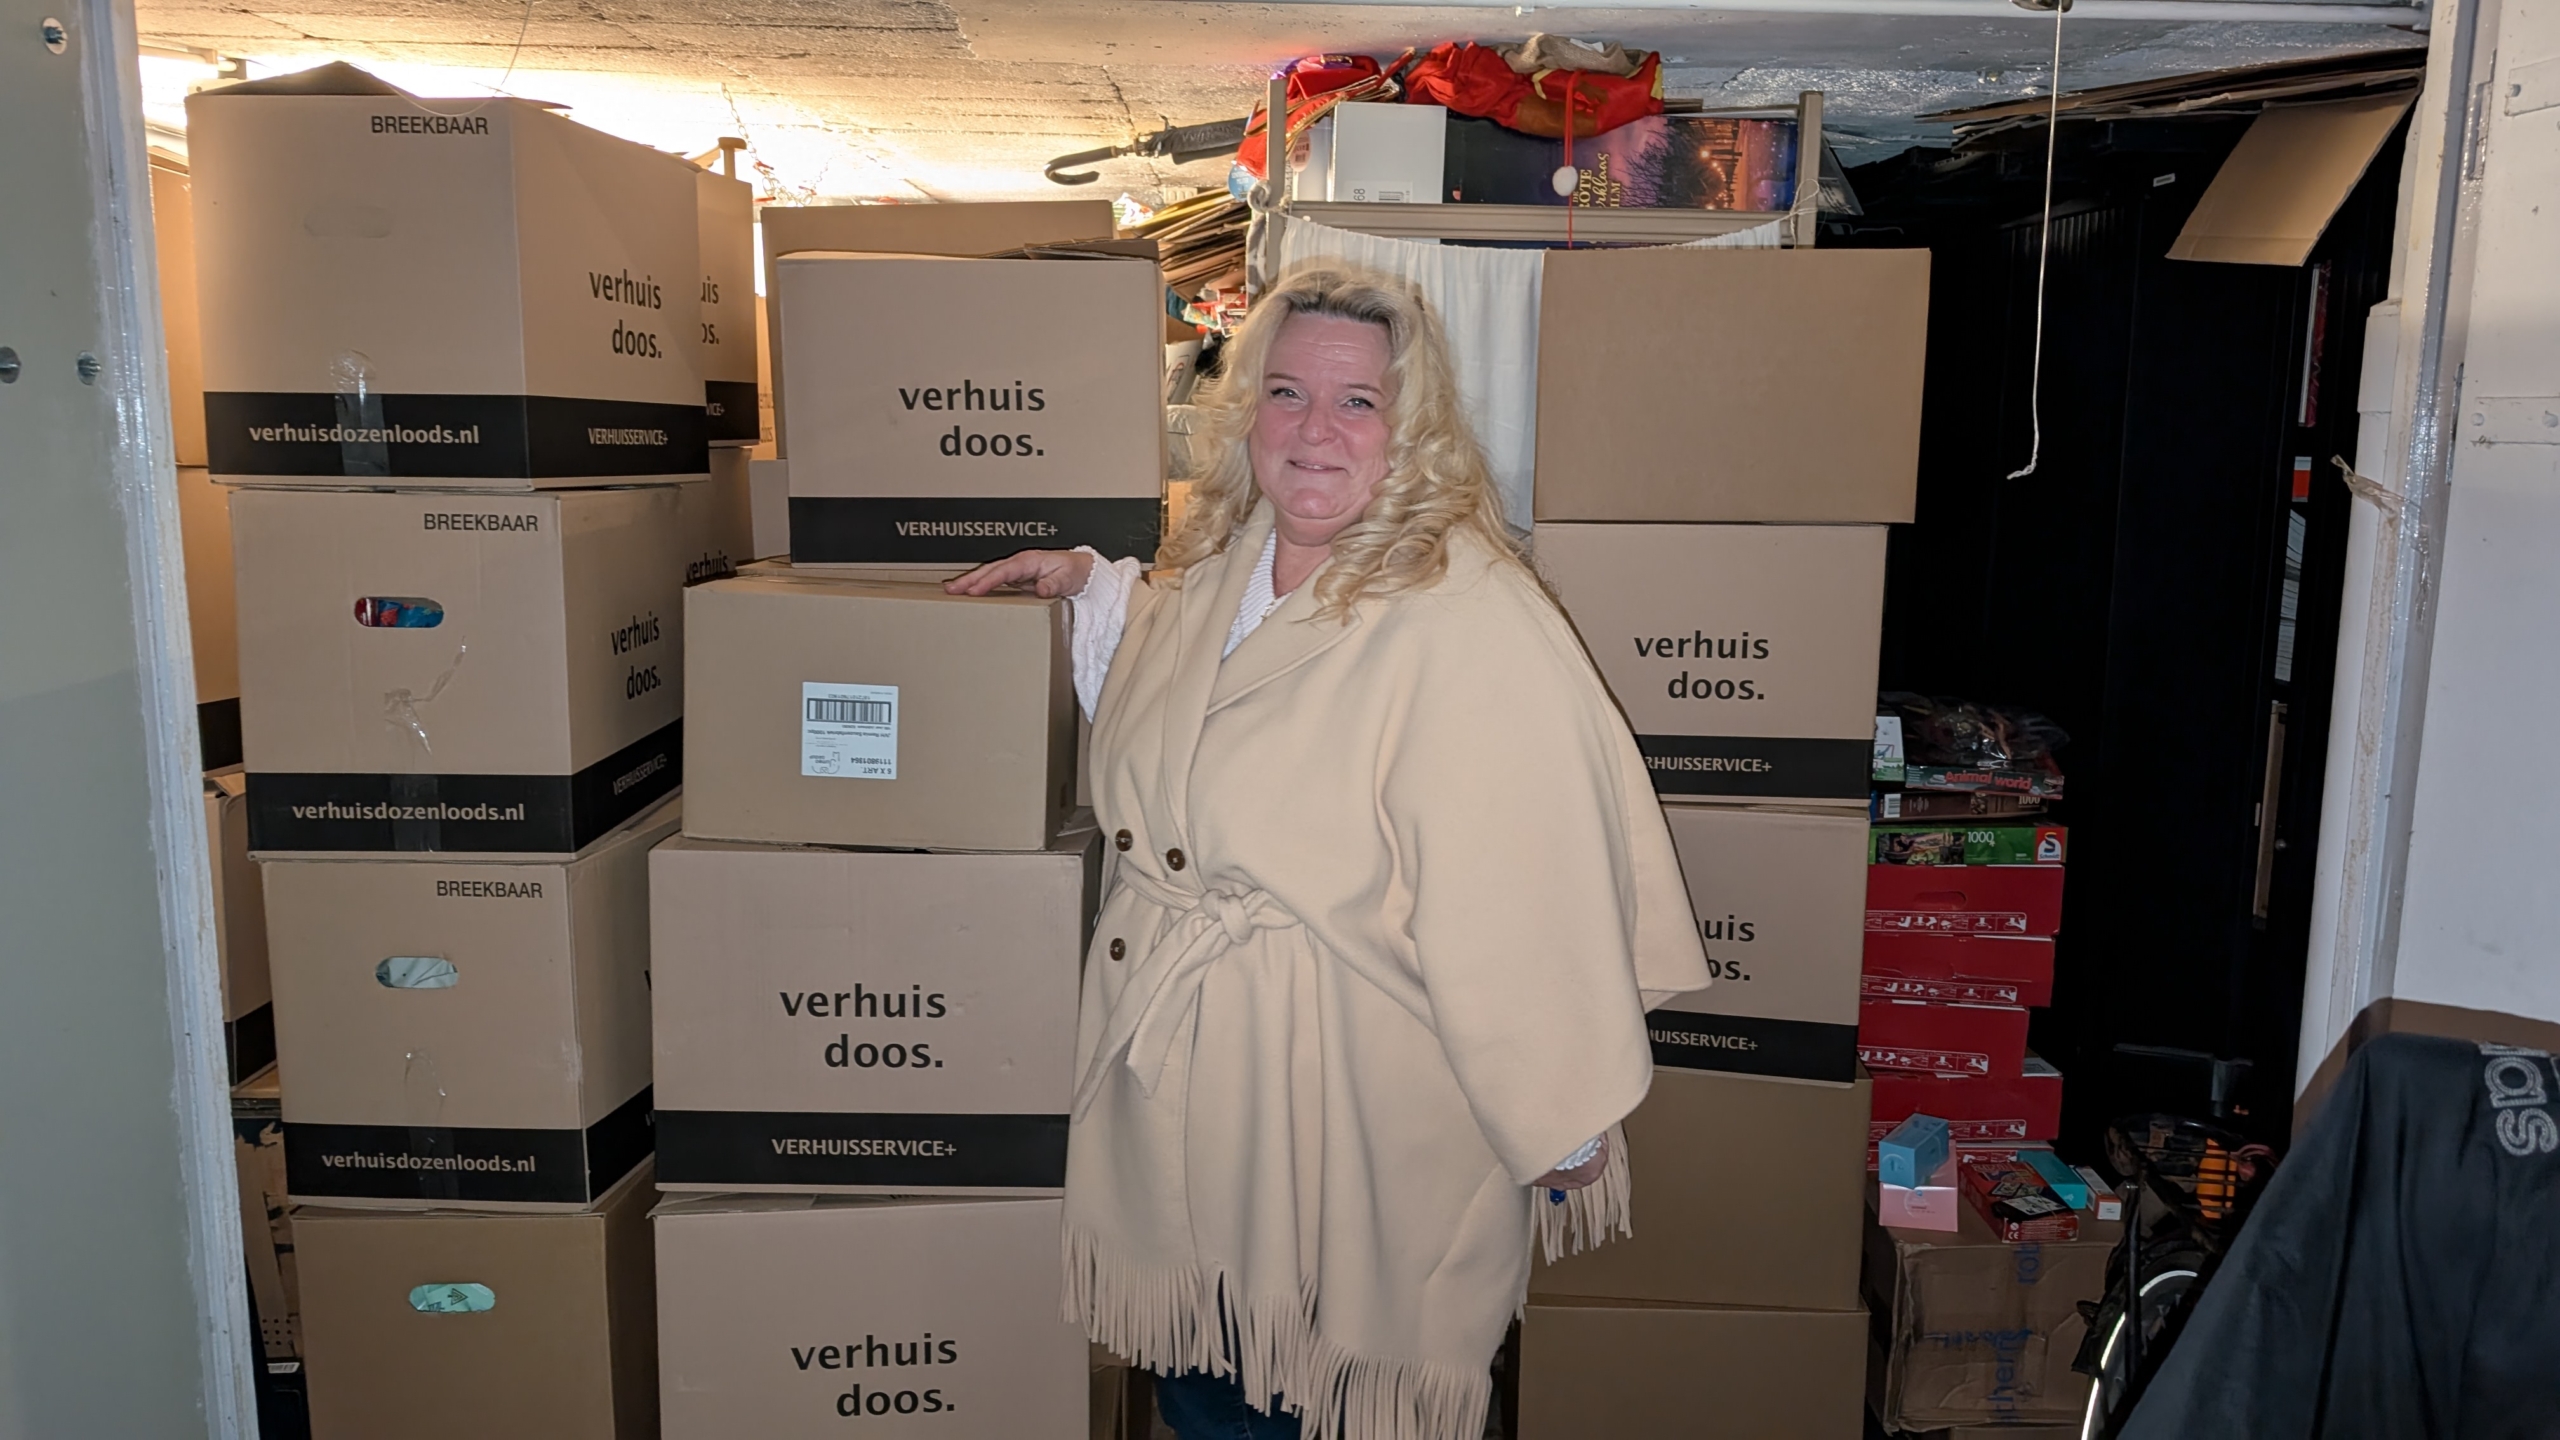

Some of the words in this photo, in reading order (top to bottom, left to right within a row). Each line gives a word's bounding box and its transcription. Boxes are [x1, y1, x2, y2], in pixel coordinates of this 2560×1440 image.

[371, 115, 489, 136] BREEKBAAR
[589, 268, 662, 310] verhuis
[612, 319, 662, 359] doos.
[898, 379, 1046, 412] verhuis
[249, 423, 479, 446] verhuisdozenloods.nl
[588, 428, 669, 446] VERHUISSERVICE+
[939, 425, 1045, 457] doos.
[423, 513, 539, 532] BREEKBAAR
[895, 521, 1059, 537] VERHUISSERVICE+
[611, 611, 660, 655] verhuis
[1634, 630, 1770, 660] verhuis
[626, 664, 661, 700] doos.
[1667, 671, 1765, 700] doos.
[1945, 770, 1992, 784] Animal
[1995, 775, 2033, 790] world
[2018, 795, 2041, 805] 1000
[291, 802, 525, 822] verhuisdozenloods.nl
[1967, 831, 1994, 843] 1000
[2038, 853, 2060, 861] Schmidt
[436, 880, 543, 899] BREEKBAAR
[779, 982, 947, 1018] verhuis
[824, 1033, 944, 1069] doos.
[771, 1138, 957, 1157] VERHUISSERVICE+
[322, 1153, 536, 1172] verhuisdozenloods.nl
[791, 1333, 957, 1370] verhuis
[836, 1384, 955, 1417] doos.
